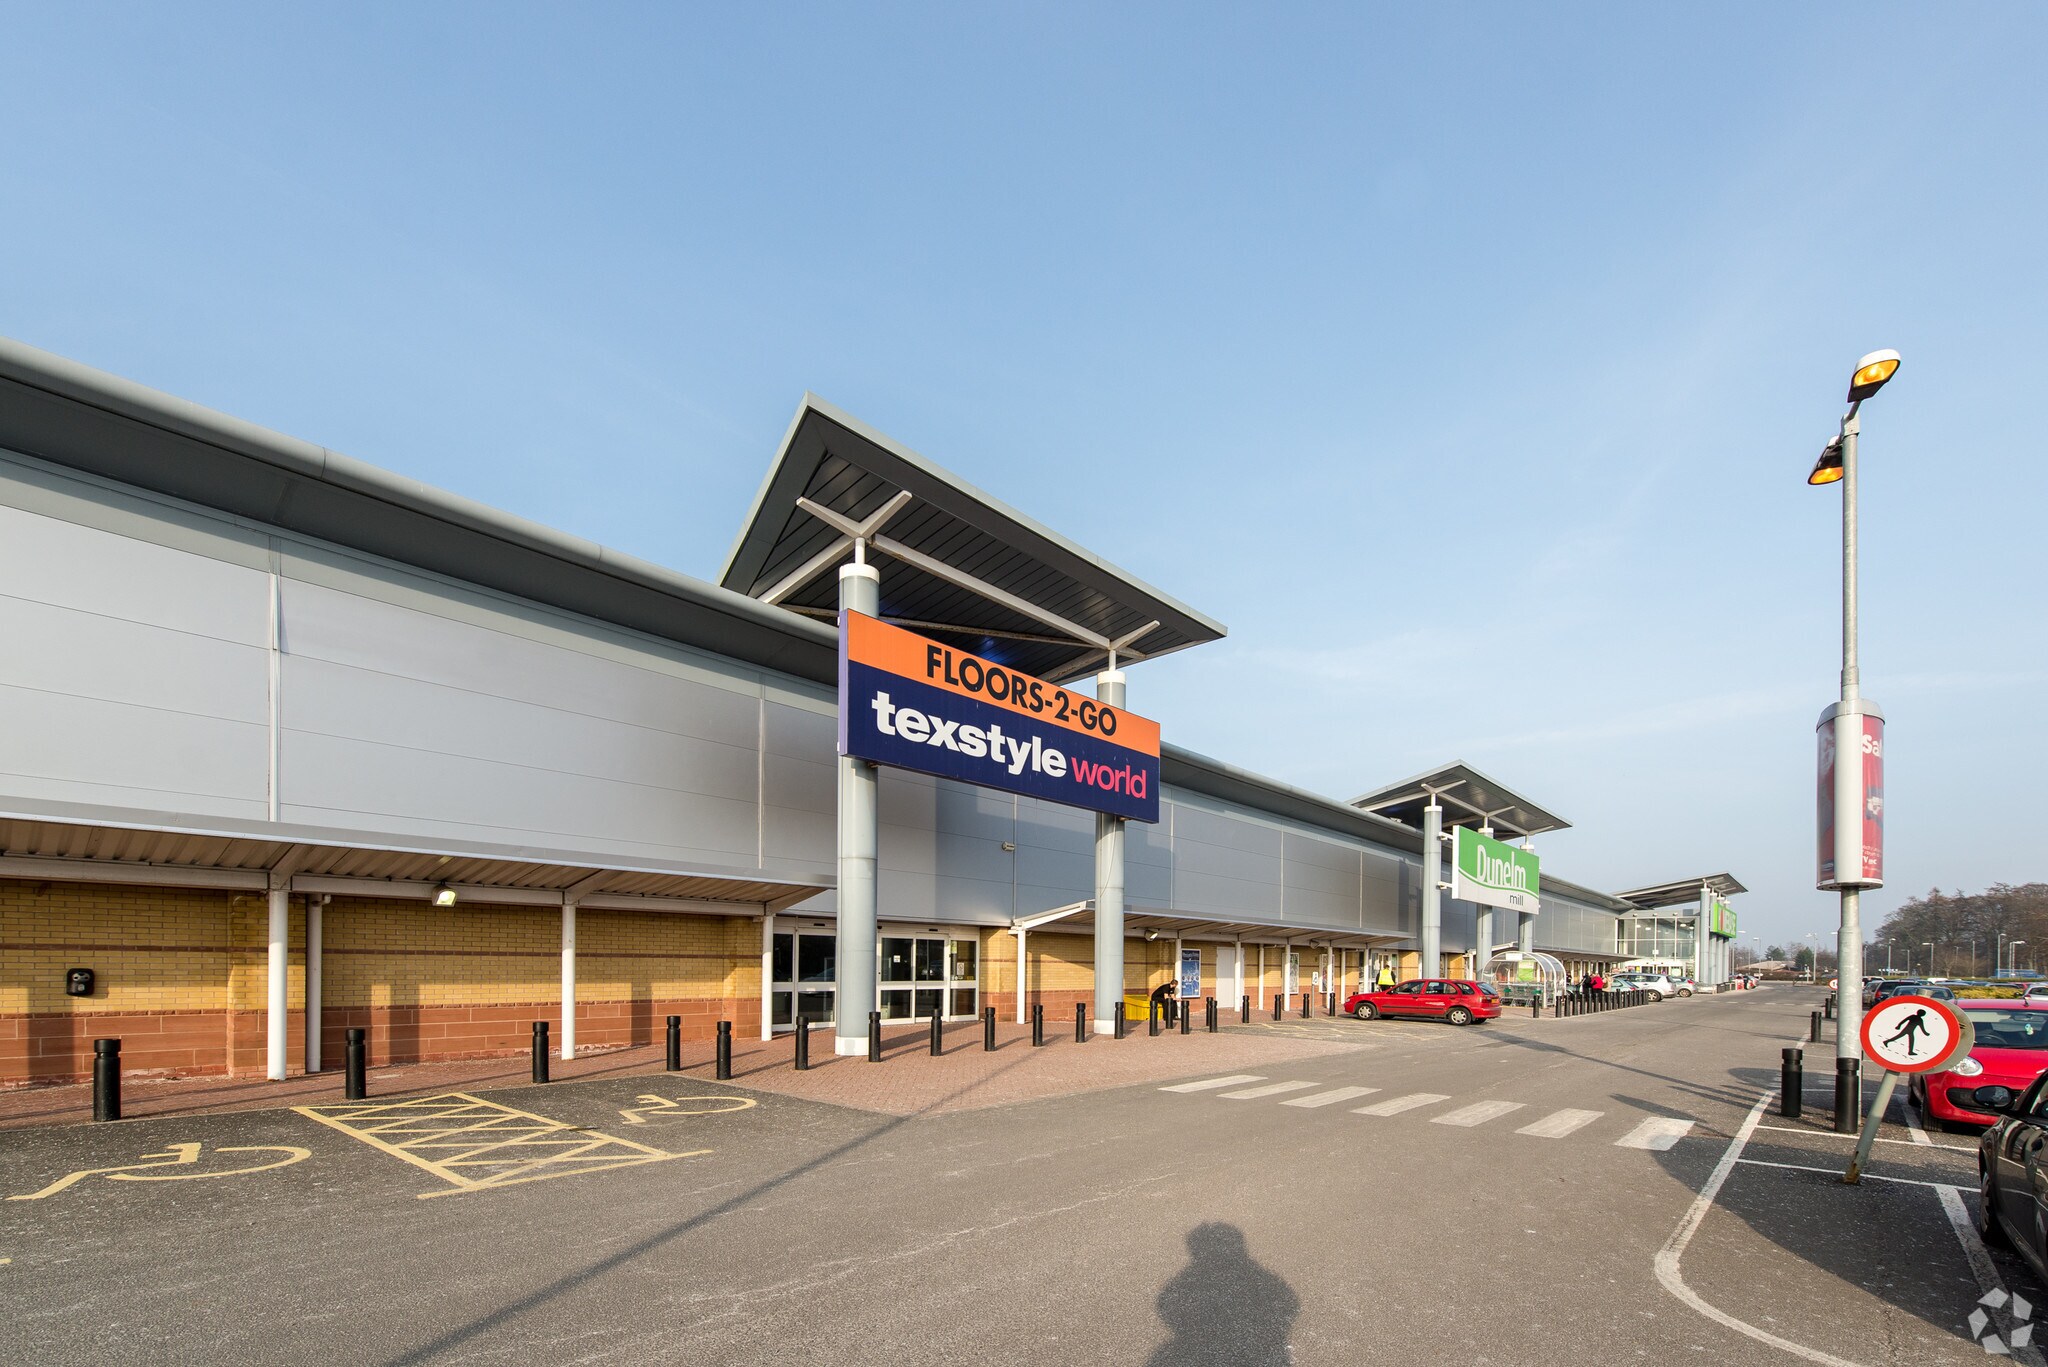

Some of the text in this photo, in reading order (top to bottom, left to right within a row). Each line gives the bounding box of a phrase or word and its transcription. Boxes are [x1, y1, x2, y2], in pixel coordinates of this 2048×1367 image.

[927, 645, 1116, 736] FLOORS-2-GO
[872, 691, 1146, 799] texstyle world
[1477, 845, 1526, 888] Dunelm
[1509, 894, 1524, 906] mill
